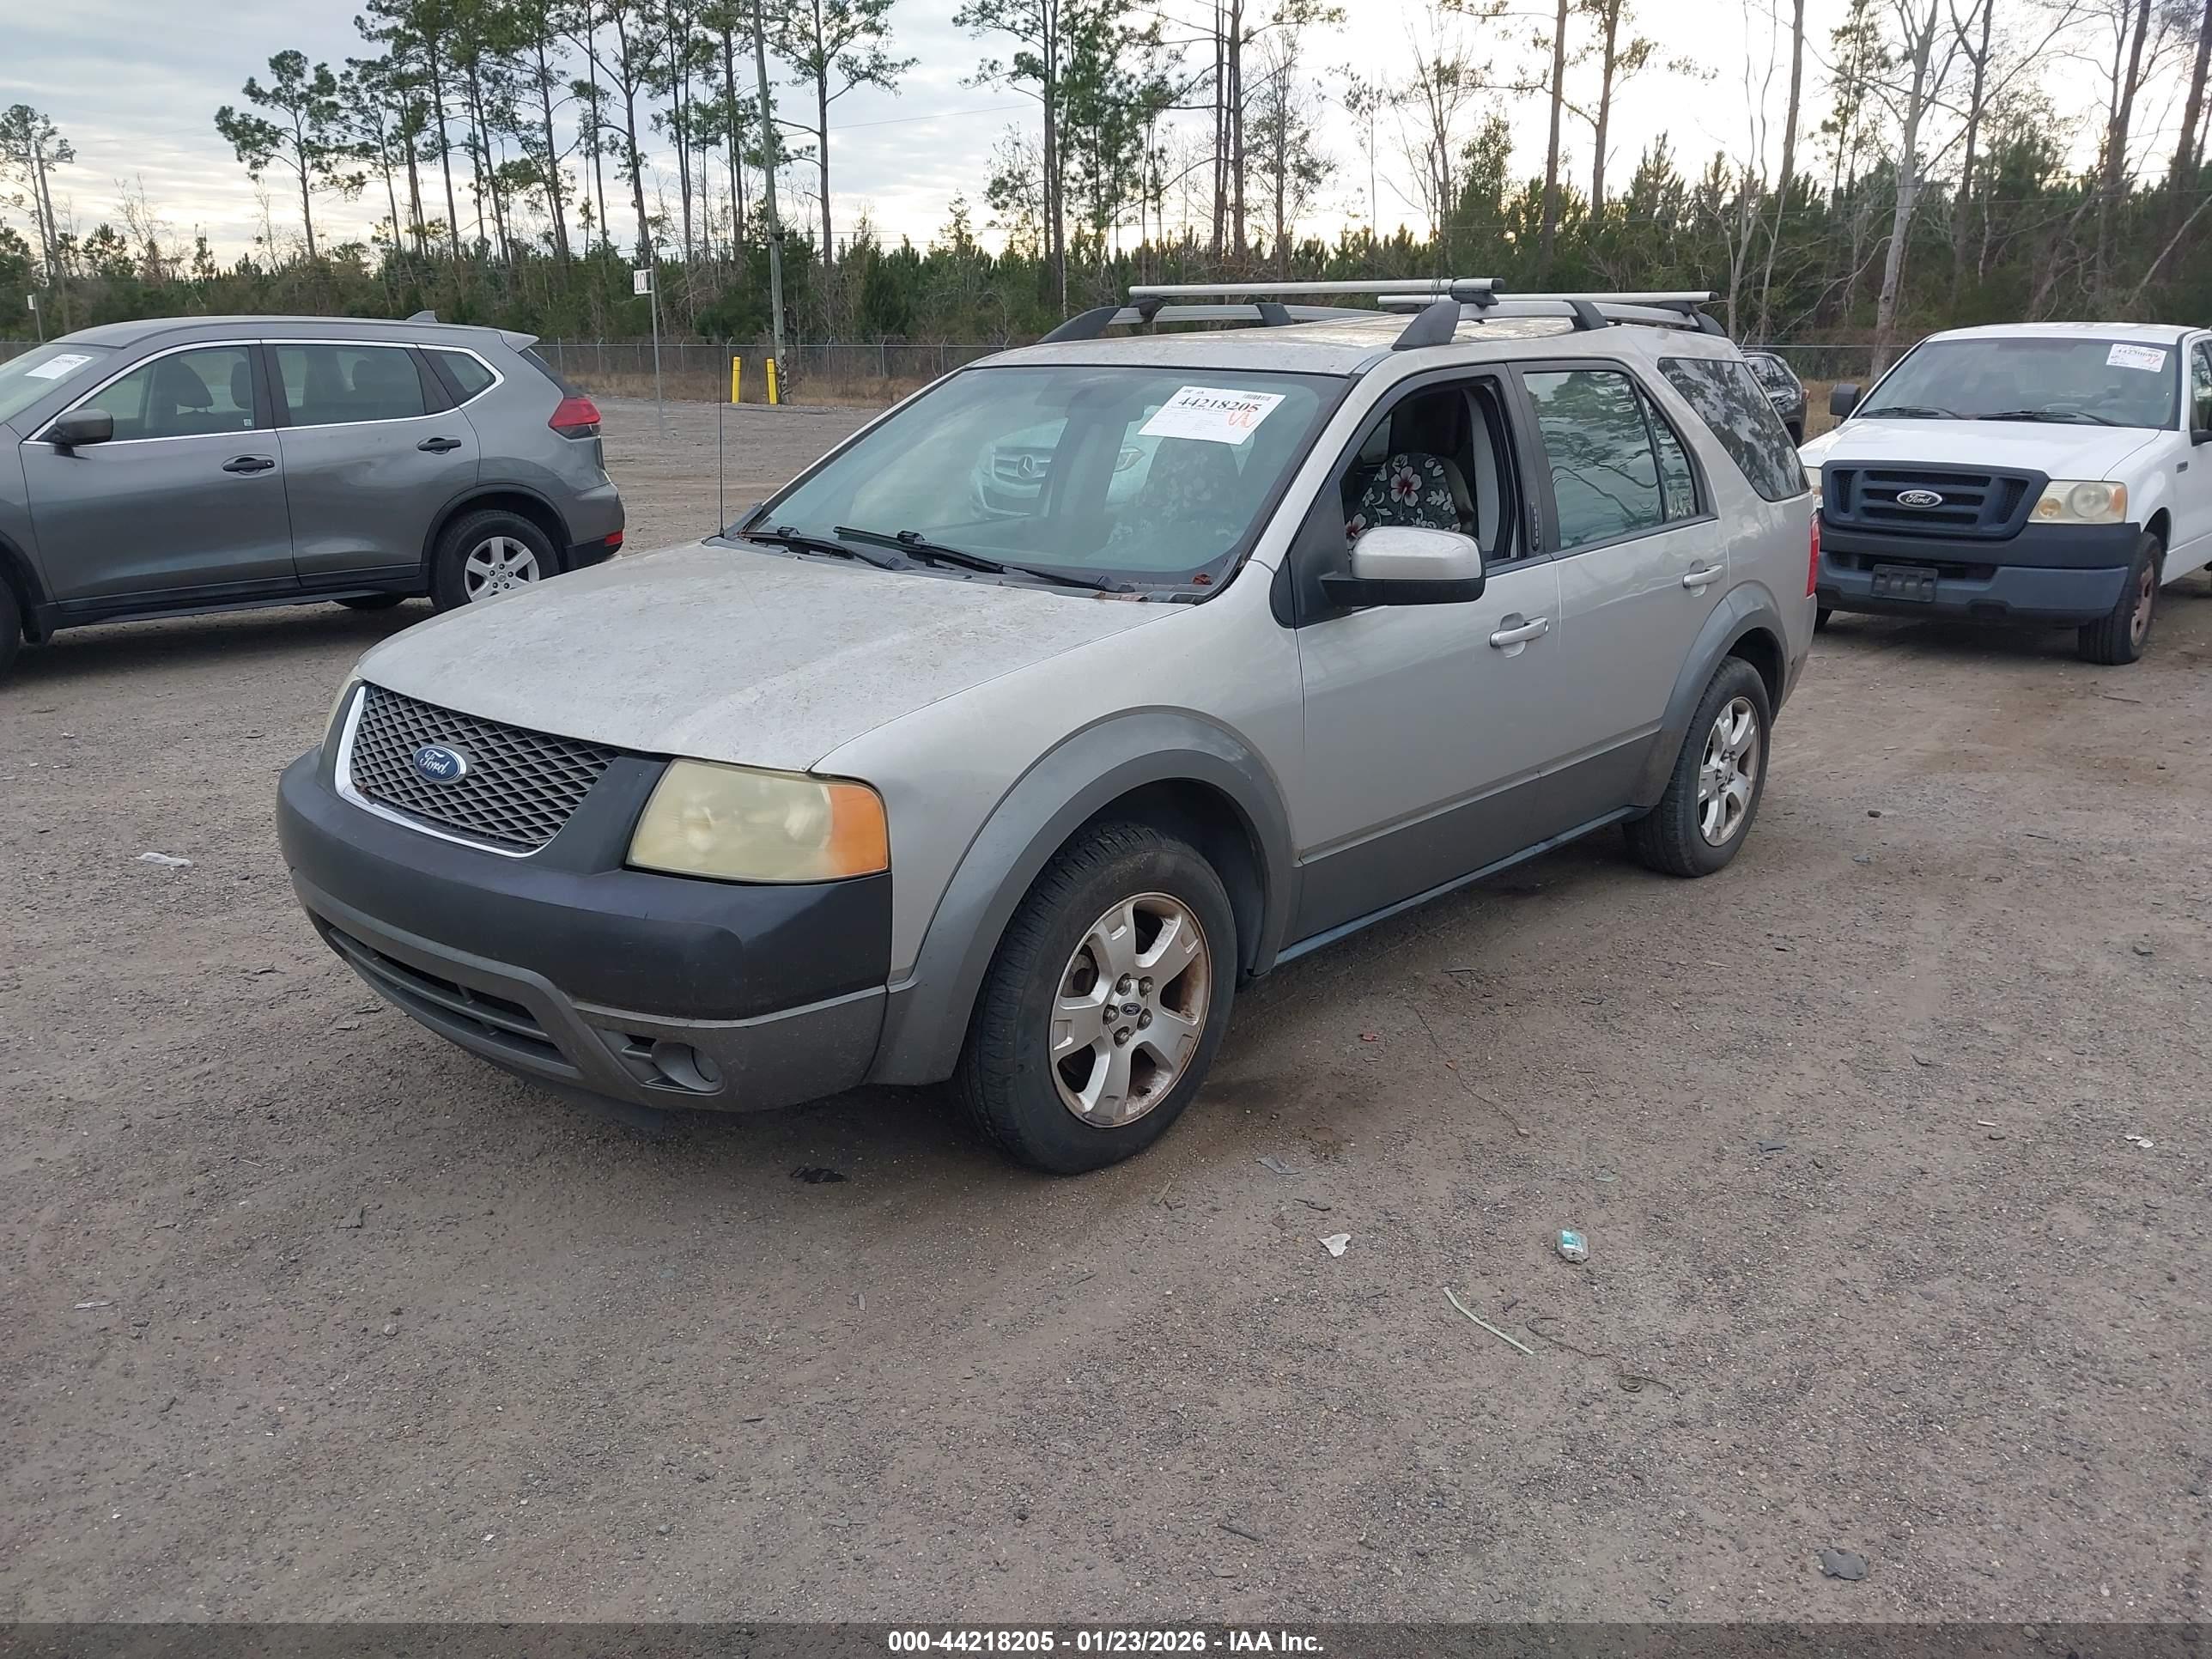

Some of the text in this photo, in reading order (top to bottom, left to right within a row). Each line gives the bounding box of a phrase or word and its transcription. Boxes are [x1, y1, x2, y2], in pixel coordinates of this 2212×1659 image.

[635, 272, 646, 291] 10
[1178, 397, 1262, 412] 44218205
[1905, 494, 1932, 504] Ford
[419, 750, 451, 775] Ford
